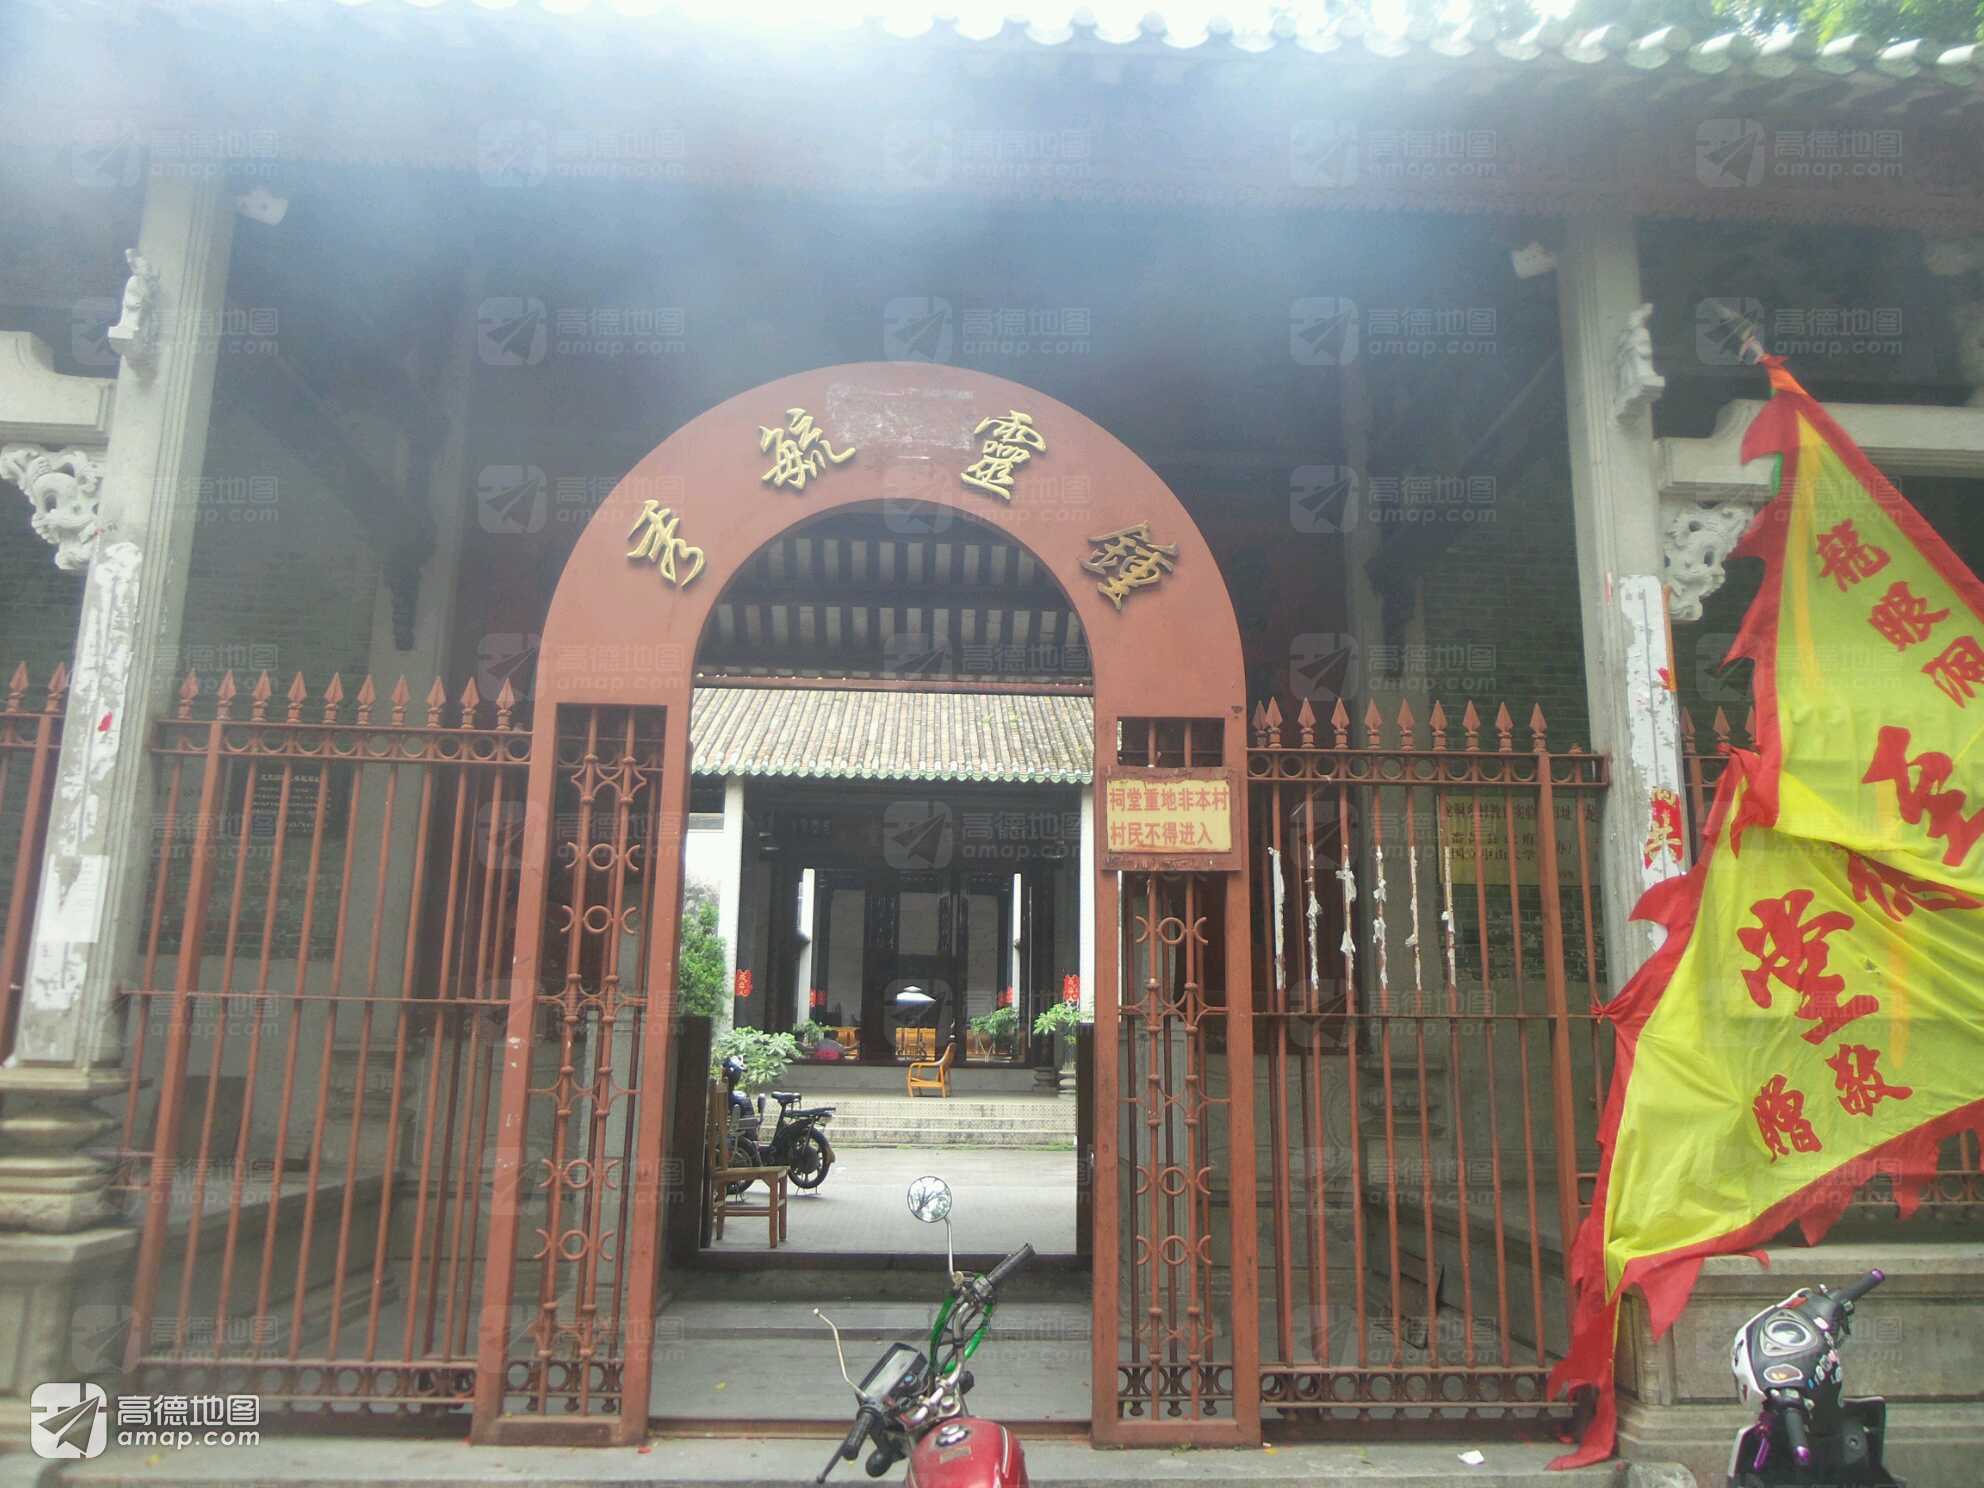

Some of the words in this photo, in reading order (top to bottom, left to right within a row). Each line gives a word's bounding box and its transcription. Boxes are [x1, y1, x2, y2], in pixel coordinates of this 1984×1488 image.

[1109, 787, 1229, 812] 祠堂重地非本村
[1110, 821, 1213, 846] 村民不得进入
